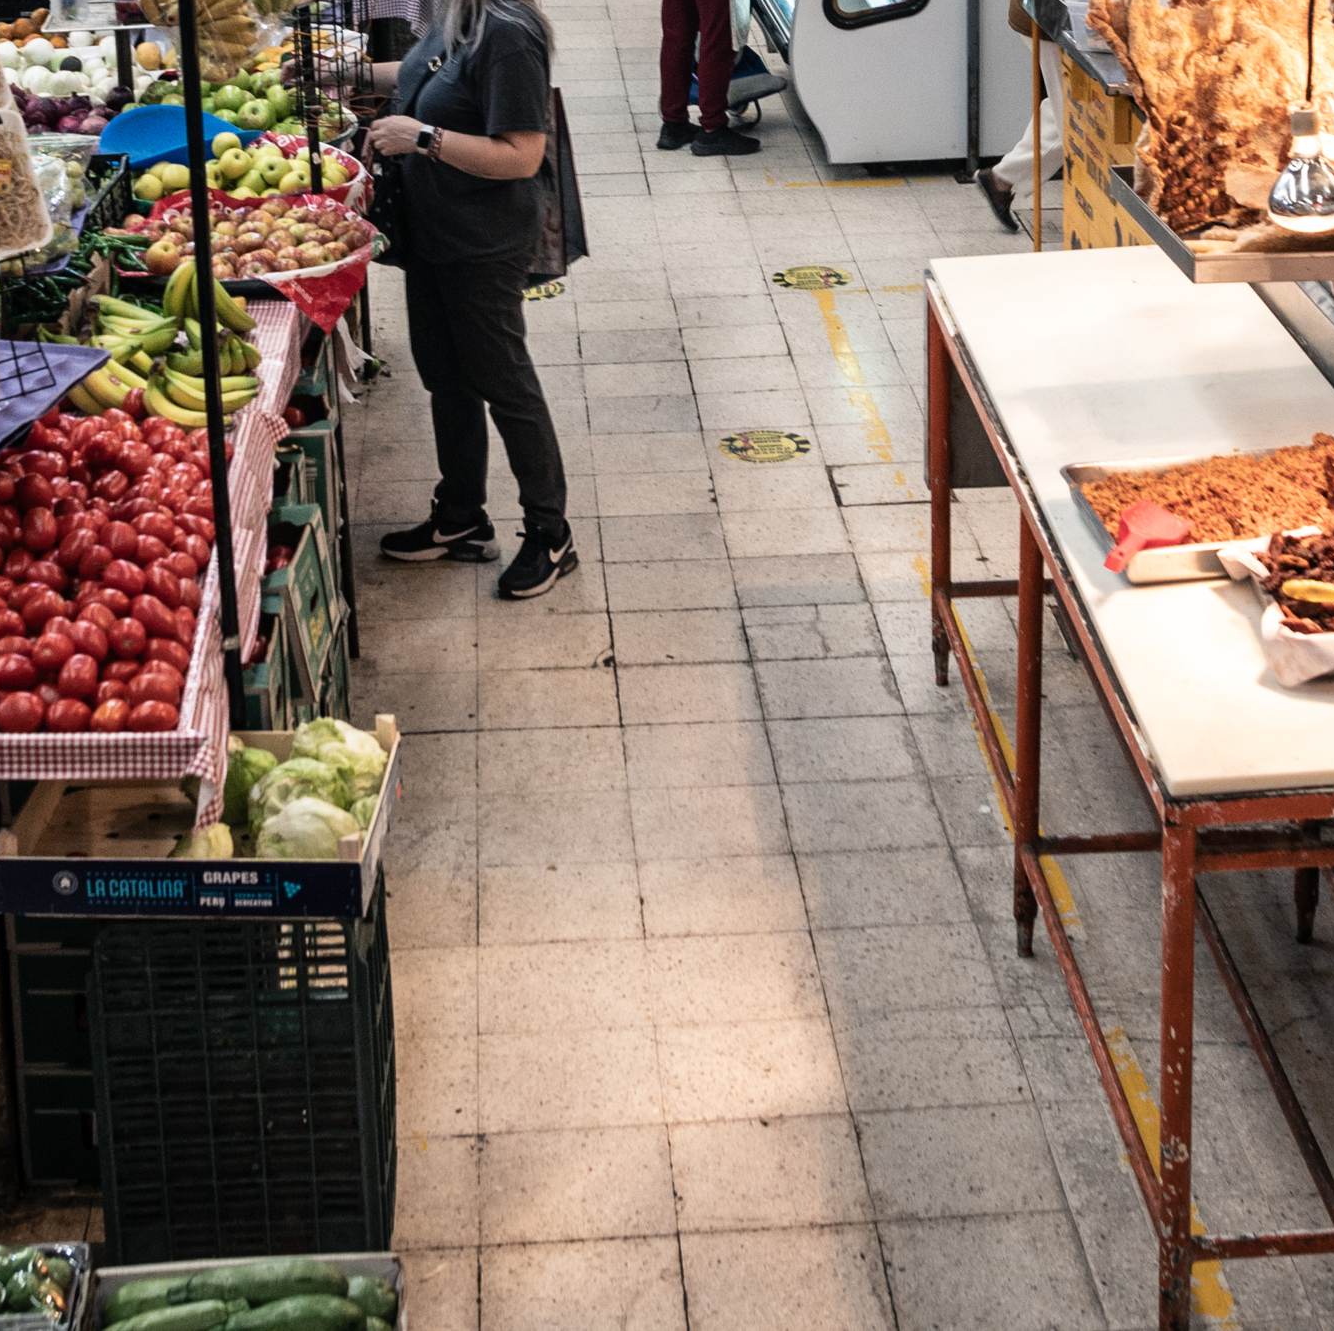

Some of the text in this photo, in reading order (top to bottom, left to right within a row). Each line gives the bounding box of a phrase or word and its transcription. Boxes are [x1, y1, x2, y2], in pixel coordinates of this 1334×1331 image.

[86, 870, 259, 899] LA CATALINA GRAPES
